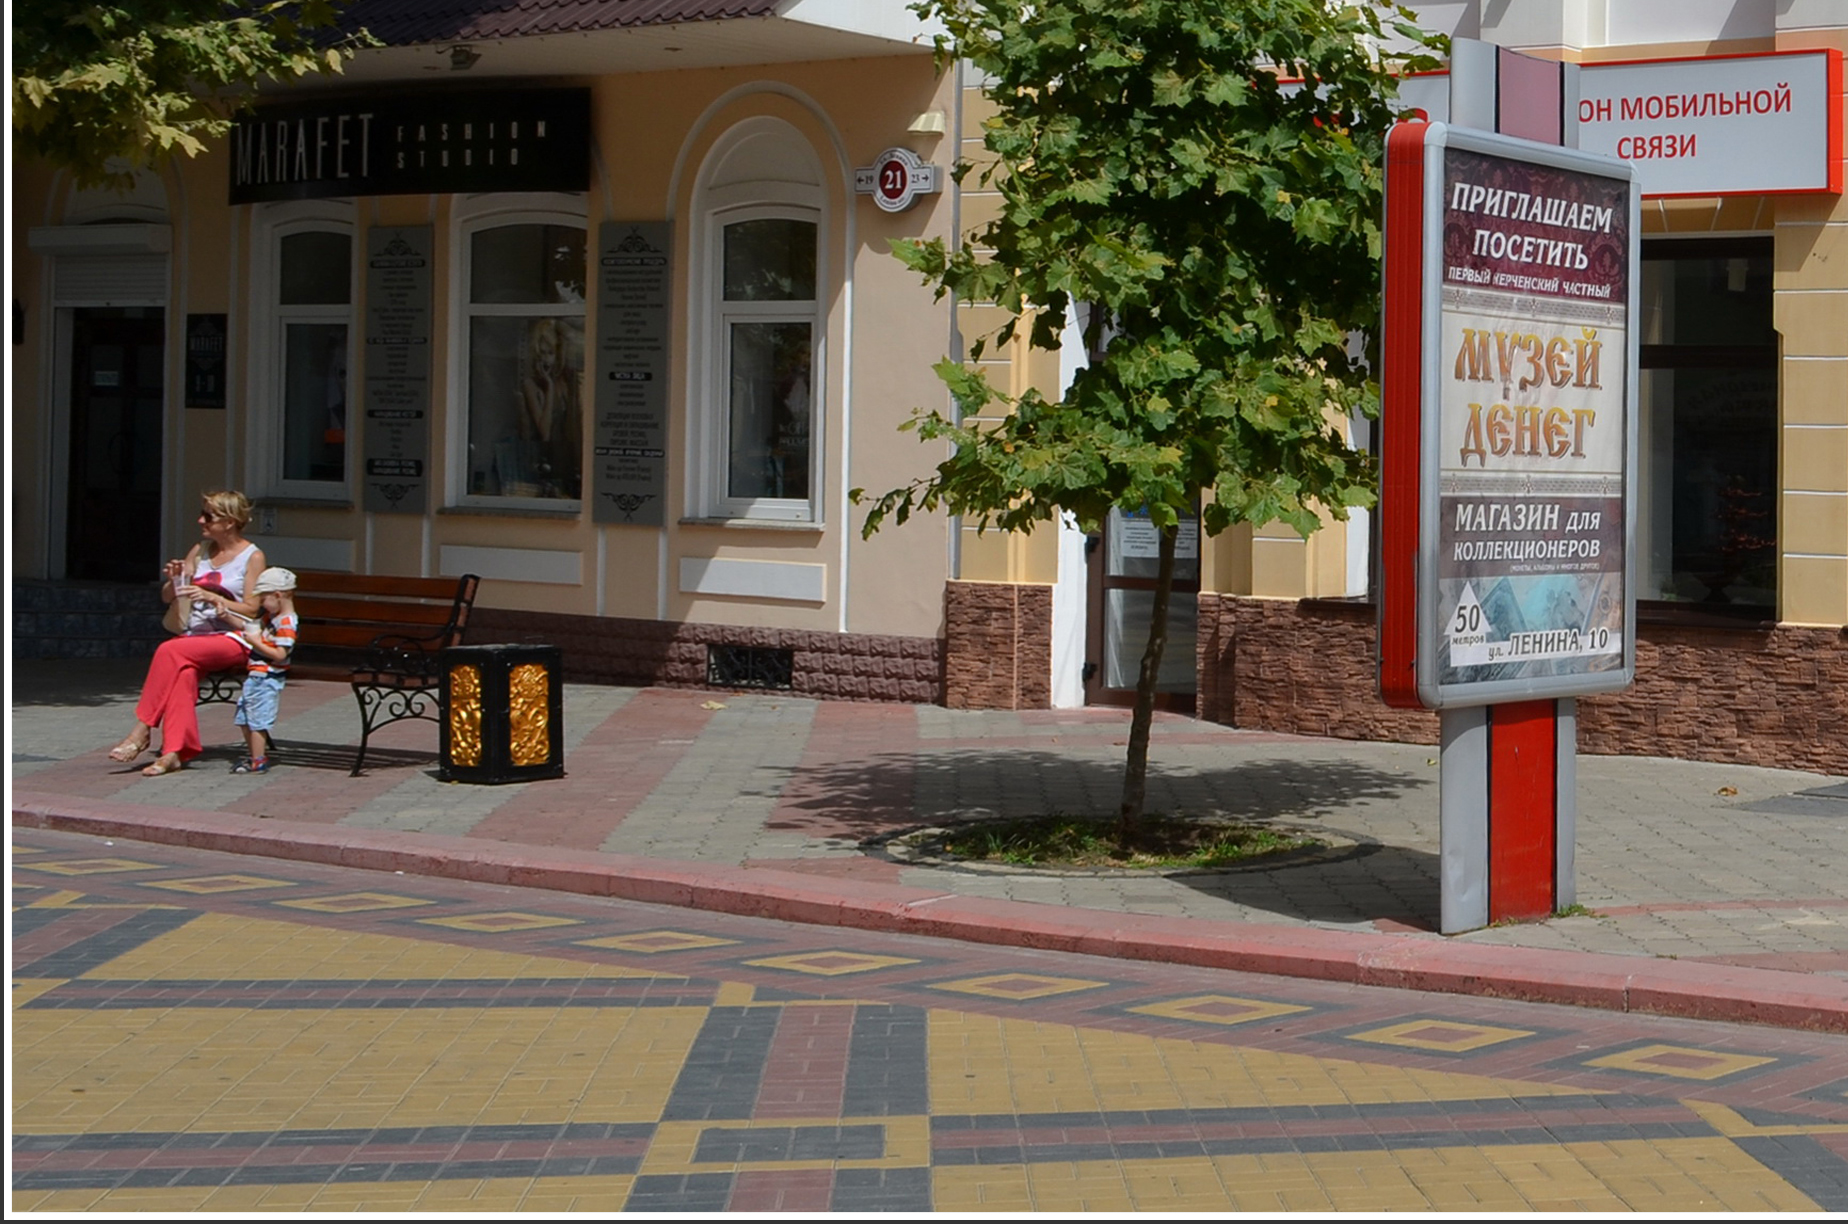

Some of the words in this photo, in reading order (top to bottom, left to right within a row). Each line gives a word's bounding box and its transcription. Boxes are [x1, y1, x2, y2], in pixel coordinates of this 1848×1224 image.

[1621, 82, 1791, 120] МОБИЛЬНОЙ
[397, 121, 545, 143] FASHION
[1617, 134, 1696, 160] СВЯЗИ
[237, 113, 373, 185] MARAFET
[397, 148, 517, 169] STUDIO
[885, 169, 902, 189] 21
[1451, 182, 1613, 233] ПРИГЛАШАЕМ
[1472, 229, 1589, 270] ПОСЕТИТЬ
[1448, 266, 1491, 284] ПЕРВЫЙ
[1562, 282, 1611, 298] ЧАСТНЫЙ
[1454, 326, 1602, 401] МУЗЕЙ
[1460, 403, 1596, 468] ДЕНЕГ
[1455, 503, 1560, 532] МАГАЗИН
[1454, 540, 1600, 563] КОЛЛЕКЦИОНЕРОВ
[1455, 604, 1480, 633] 50
[1452, 634, 1484, 647] метров
[1489, 646, 1504, 661] ул.
[1508, 630, 1583, 656] ЛЕНИНА,
[1589, 628, 1608, 650] 10
